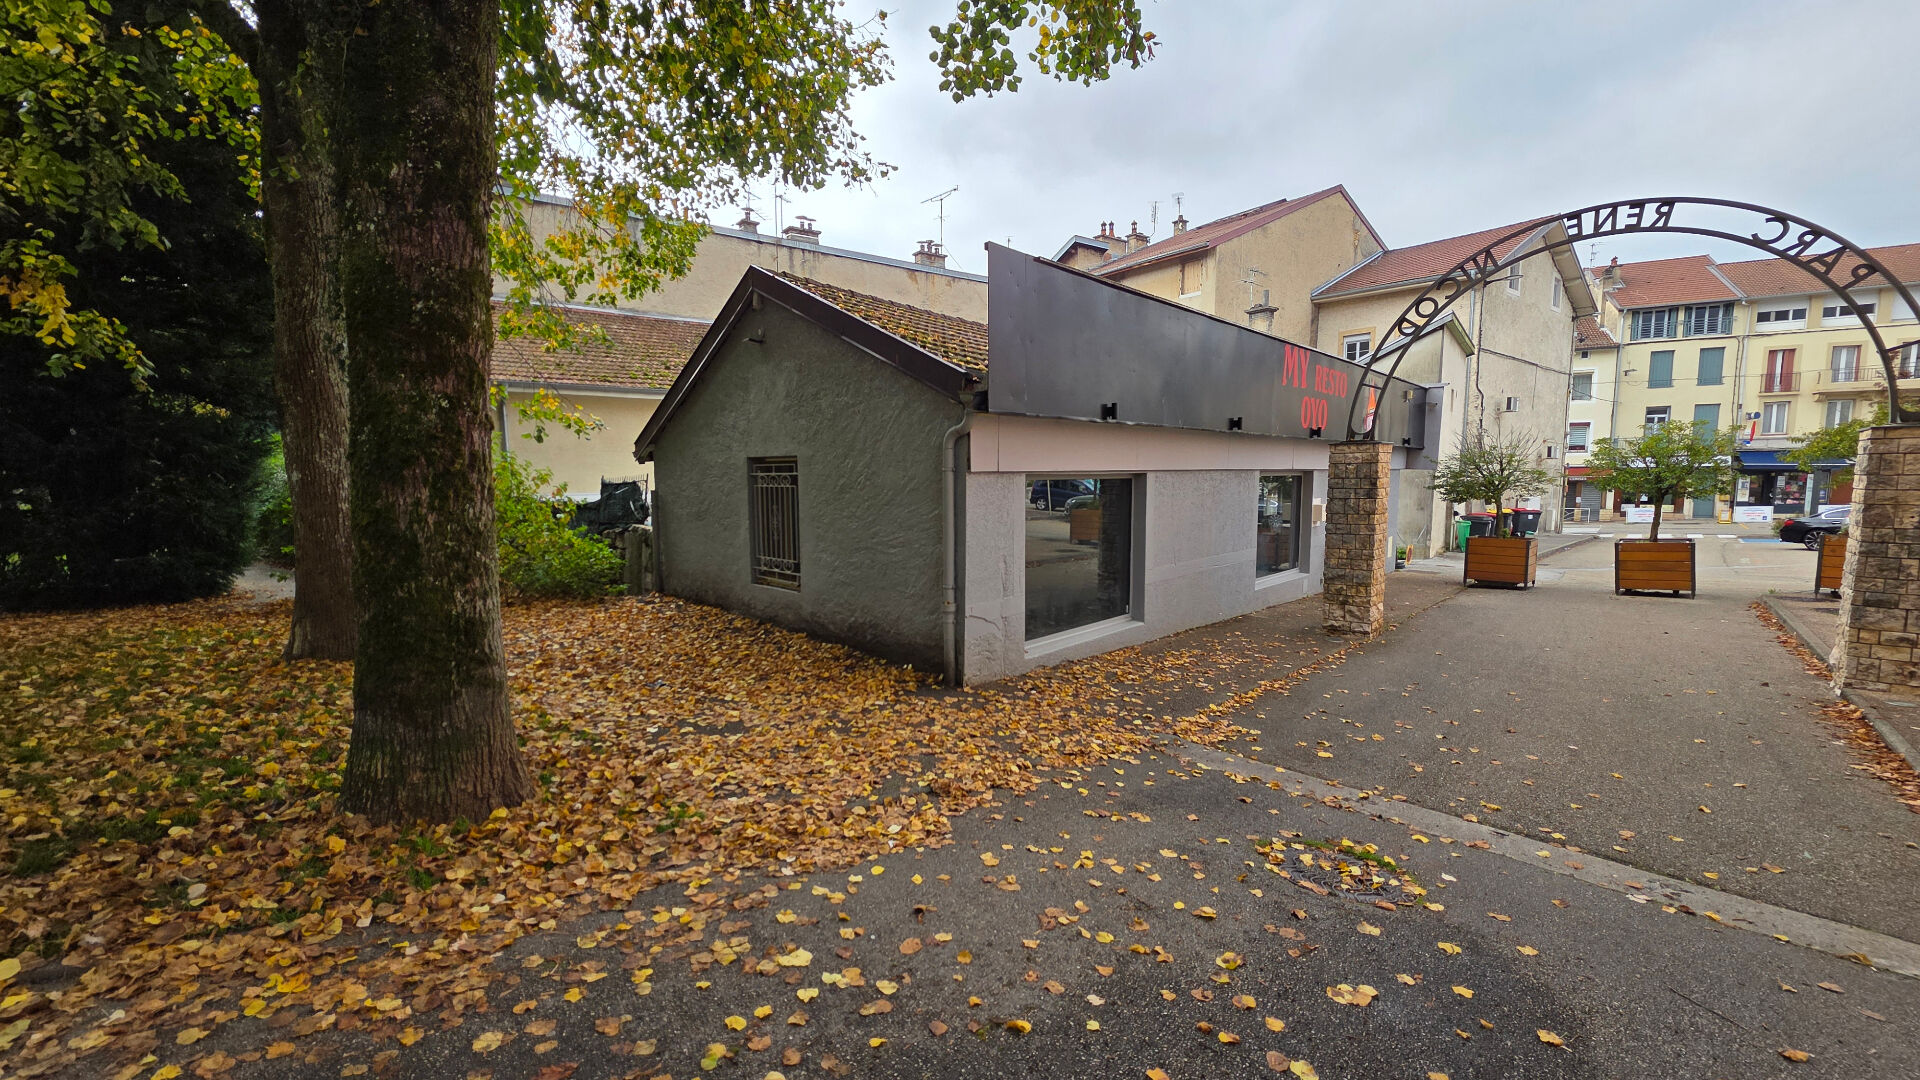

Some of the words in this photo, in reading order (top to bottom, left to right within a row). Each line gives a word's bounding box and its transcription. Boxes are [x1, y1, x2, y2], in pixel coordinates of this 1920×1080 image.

[1282, 343, 1311, 389] MY
[1315, 364, 1348, 398] RESTO
[1301, 396, 1328, 430] OYO
